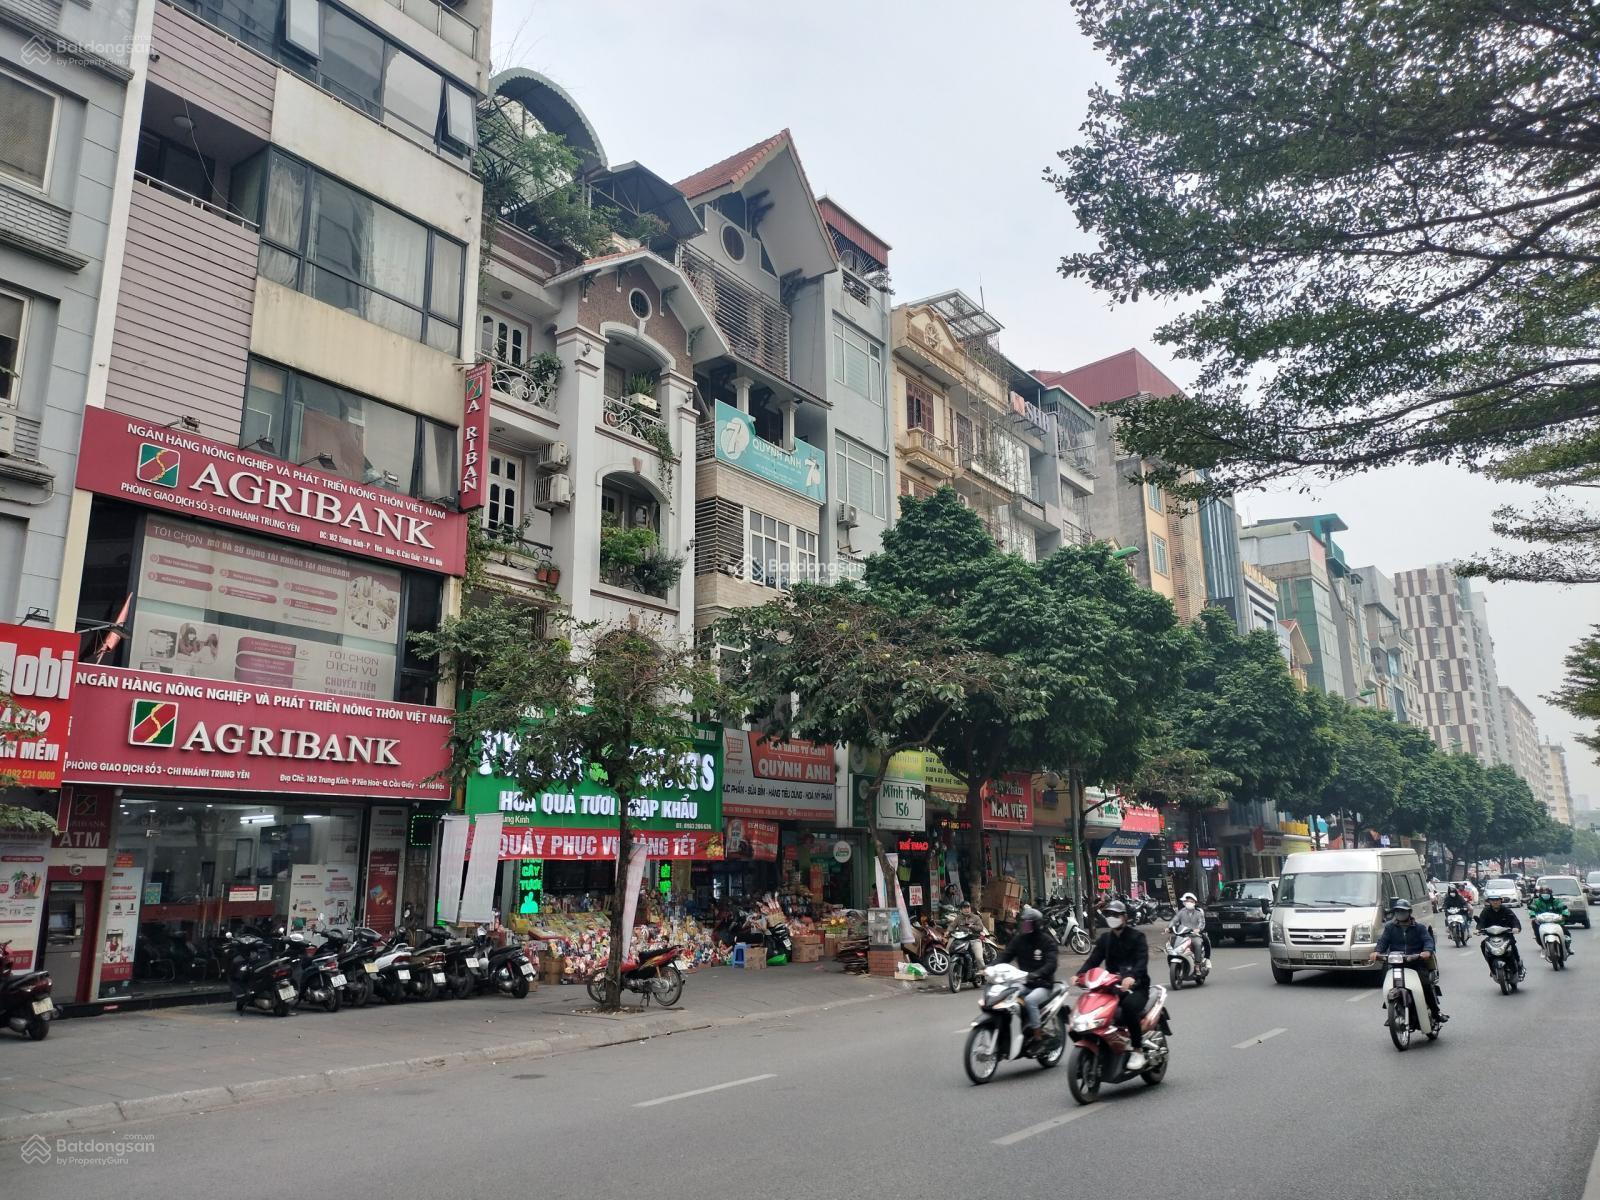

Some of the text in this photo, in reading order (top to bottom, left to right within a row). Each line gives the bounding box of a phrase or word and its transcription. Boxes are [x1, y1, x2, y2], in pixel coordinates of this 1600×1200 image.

[128, 424, 446, 520] NGÂN HÀNG NÔNG NGHIỆP VÀ PHÁT TRIỂN NÔNG THÔN VIỆT NAM
[121, 482, 151, 498] PHÒNG
[154, 490, 174, 503] GIAO
[176, 496, 194, 509] DỊCH
[196, 499, 207, 511] SỐ
[232, 510, 258, 523] NHÁNH
[260, 516, 284, 530] TRUNG
[286, 522, 300, 533] YÊN
[189, 462, 435, 549] AGRIBANK
[76, 672, 452, 725] NGÂN HÀNG NÔNG NGHIỆP VÀ PHÁT TRIỂN NÔNG THÔN VIỆT NAM
[20, 737, 60, 760] MỀM
[182, 721, 401, 766] AGRIBANK
[66, 759, 98, 770] PHÒNG
[100, 763, 121, 772] GIAO
[122, 764, 142, 776] DỊCH
[168, 766, 181, 776] CHI
[182, 766, 208, 778] NHÁNH
[211, 769, 234, 779] TRUNG
[236, 769, 250, 779] YÊN
[758, 756, 830, 780] QUỲNH ANH
[306, 775, 316, 784] 162
[318, 776, 335, 786] Trung
[500, 790, 536, 812] HOA
[541, 788, 576, 814] QUẢ
[580, 794, 614, 816] TƯƠI
[618, 794, 659, 820] HẬP
[661, 794, 698, 820] KHẨU
[896, 802, 909, 816] 156
[1011, 799, 1028, 822] VIỆT
[514, 816, 530, 824] Kính
[59, 832, 100, 848] ATM
[499, 828, 546, 857] QUẦY
[551, 836, 598, 860] PHỤC
[673, 833, 696, 856] TẾT
